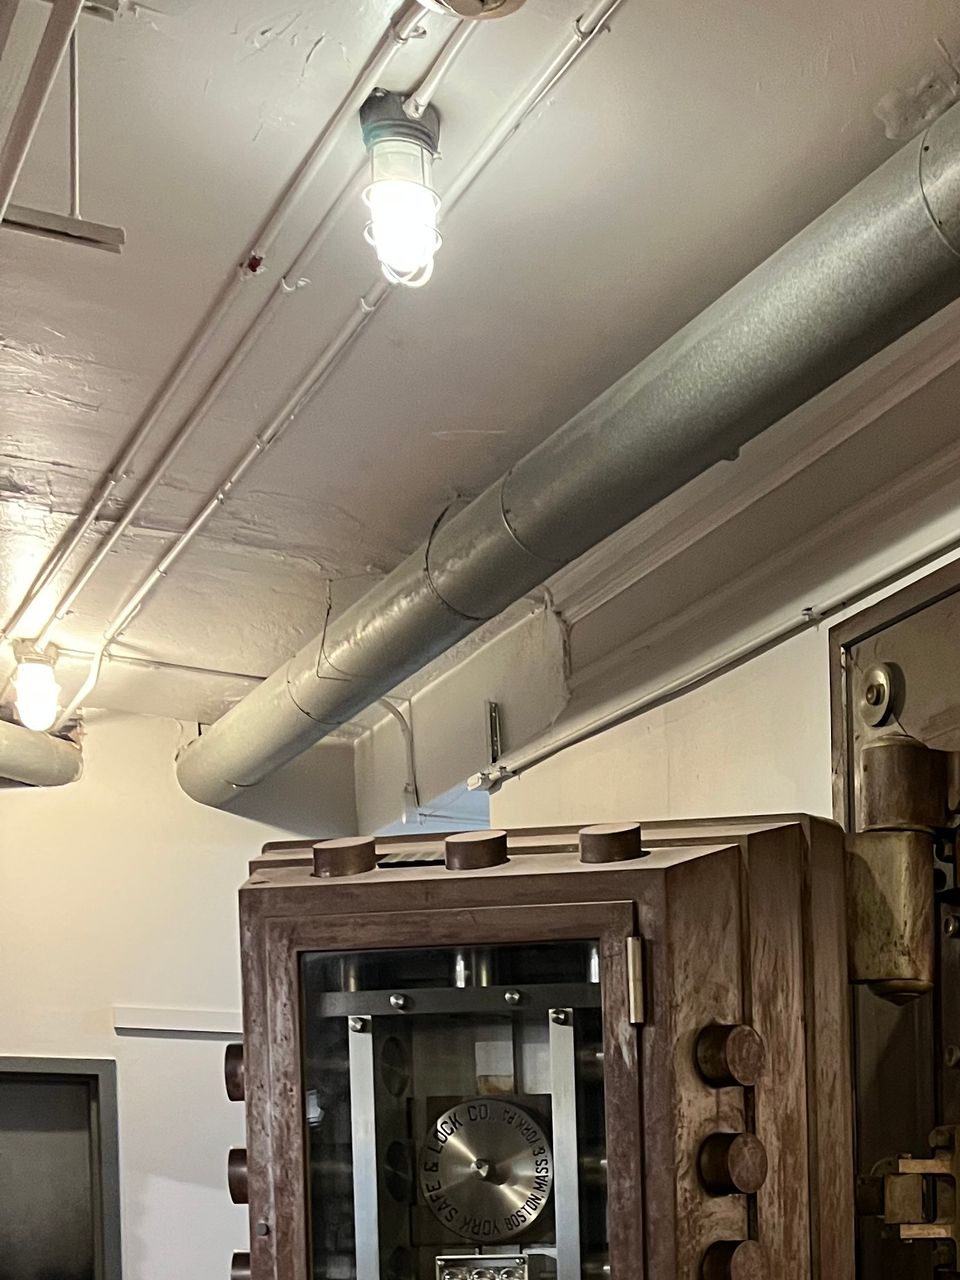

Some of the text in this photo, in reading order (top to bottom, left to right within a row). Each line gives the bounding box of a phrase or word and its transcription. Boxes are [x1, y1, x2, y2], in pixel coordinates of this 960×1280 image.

[428, 1113, 463, 1153] LOCK
[533, 1146, 545, 1156] &
[424, 1162, 439, 1172] &
[426, 1181, 458, 1222] SAFE
[460, 1216, 501, 1236] YORK
